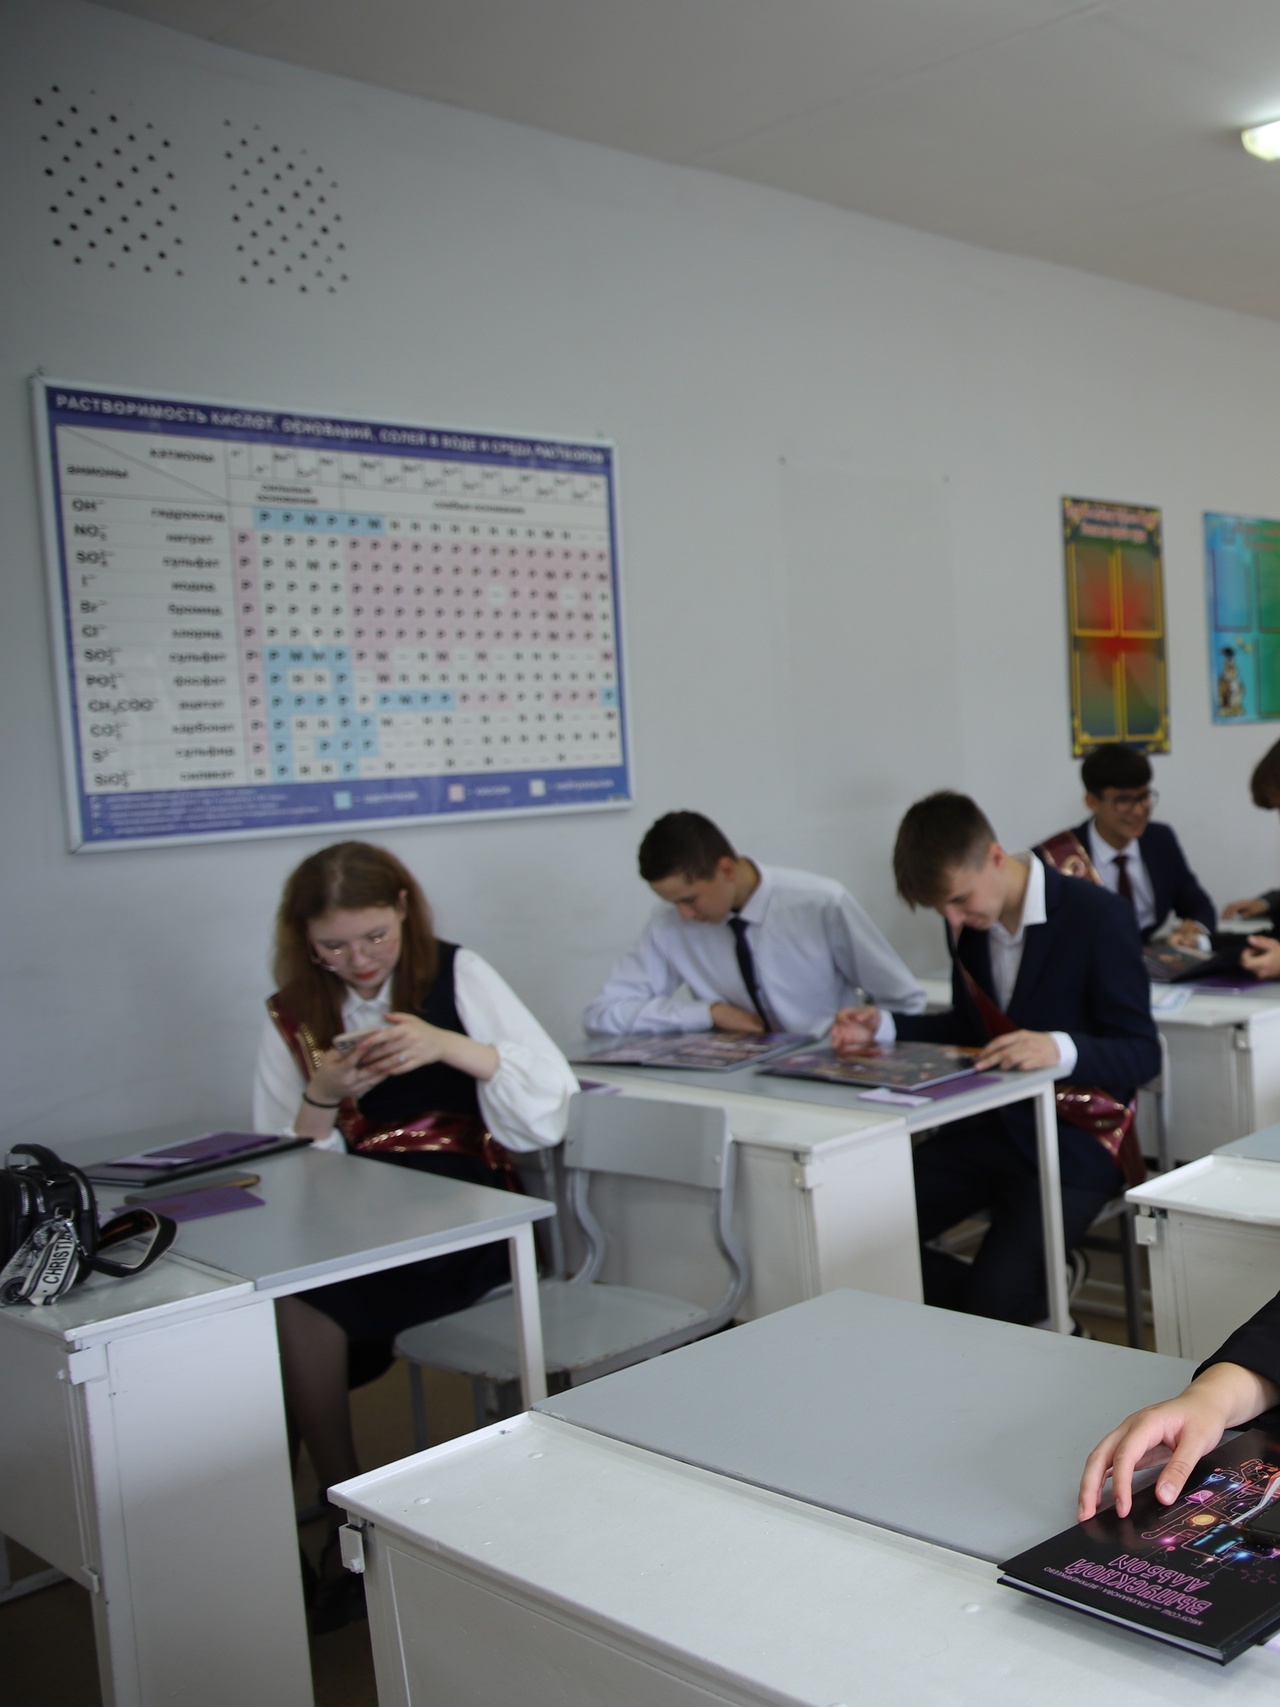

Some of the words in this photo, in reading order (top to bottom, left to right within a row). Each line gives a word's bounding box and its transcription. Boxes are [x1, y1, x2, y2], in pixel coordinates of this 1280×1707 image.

[55, 394, 208, 424] РАСТВОРИМОСТЬ
[42, 1231, 73, 1284] CHRISTIA
[1065, 1559, 1212, 1615] ВЫПУСКНОЙ
[1108, 1553, 1211, 1593] АЛЬБОМ
[1161, 1610, 1181, 1621] СОШ
